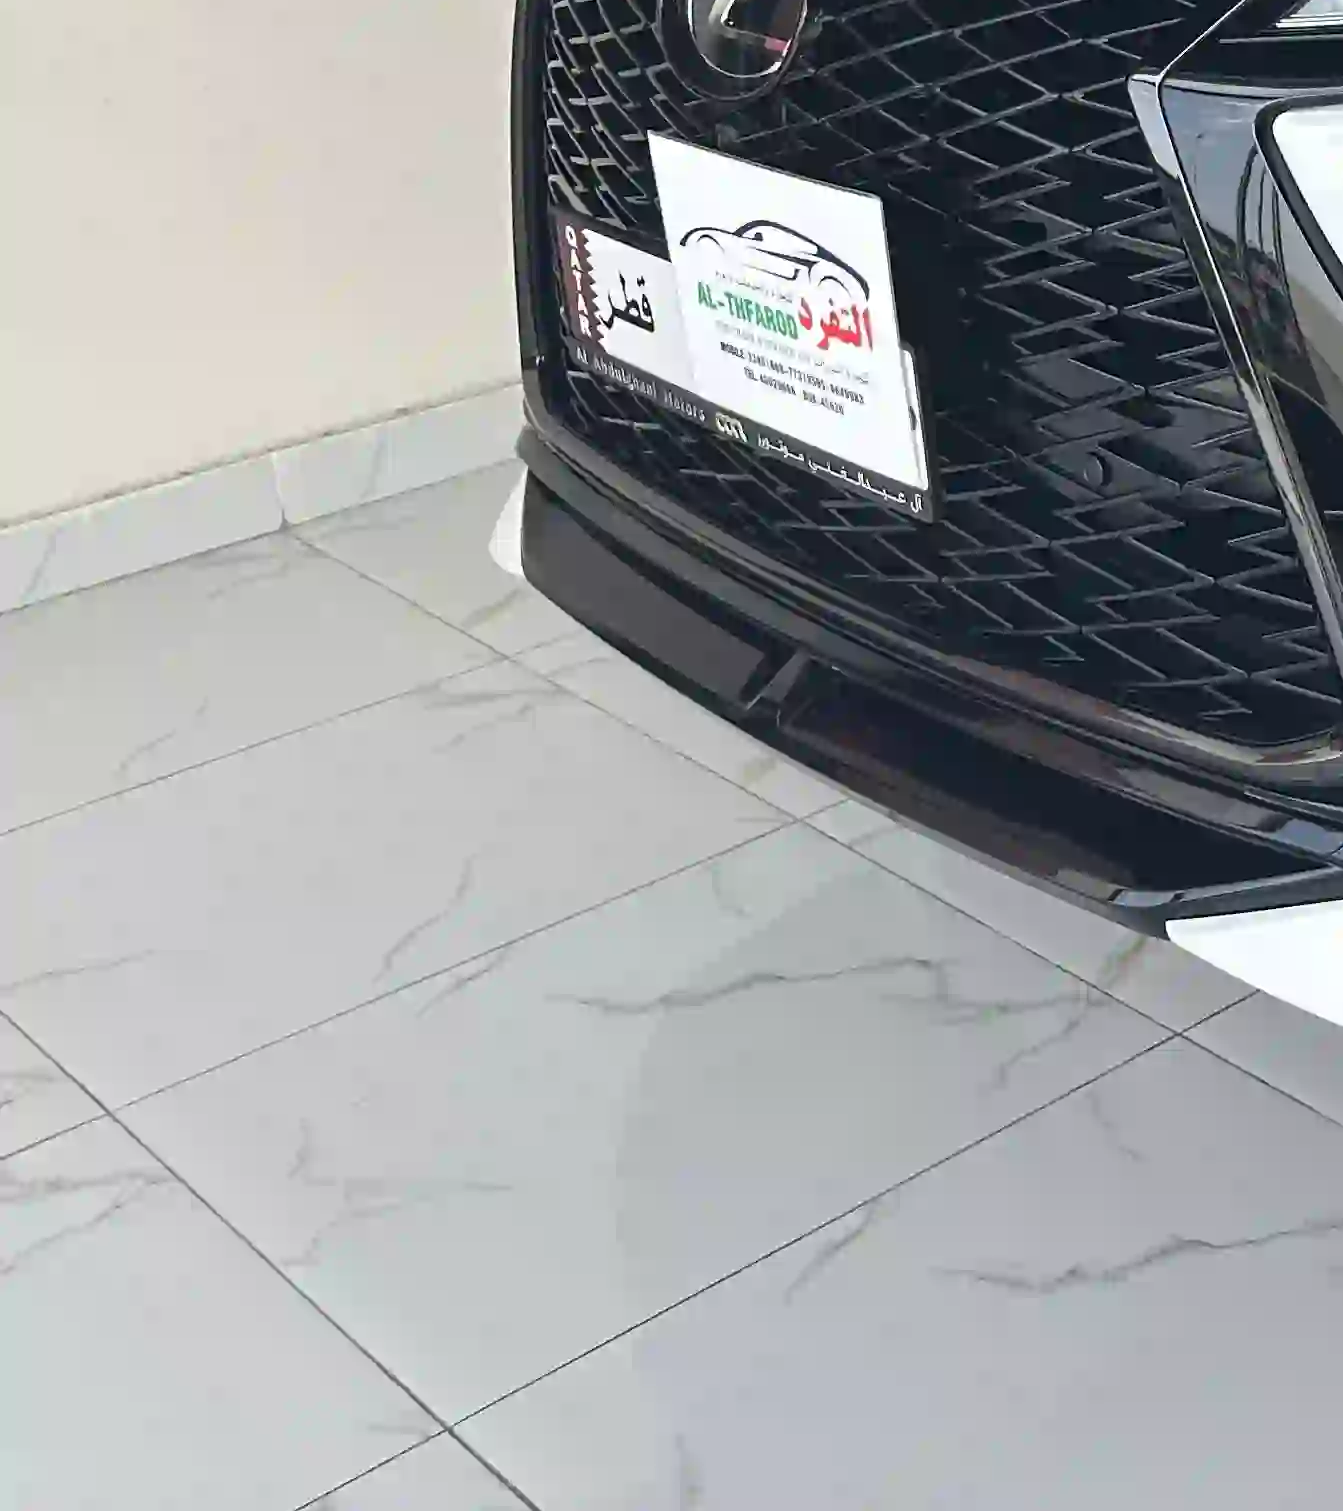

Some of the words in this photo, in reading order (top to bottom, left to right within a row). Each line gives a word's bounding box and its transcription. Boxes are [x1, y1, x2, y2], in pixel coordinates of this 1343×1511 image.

[565, 224, 592, 339] QATAR
[599, 268, 655, 332] قطر
[798, 297, 873, 352] التفرد
[664, 390, 706, 422] Motors
[808, 458, 907, 503] عبدالغني
